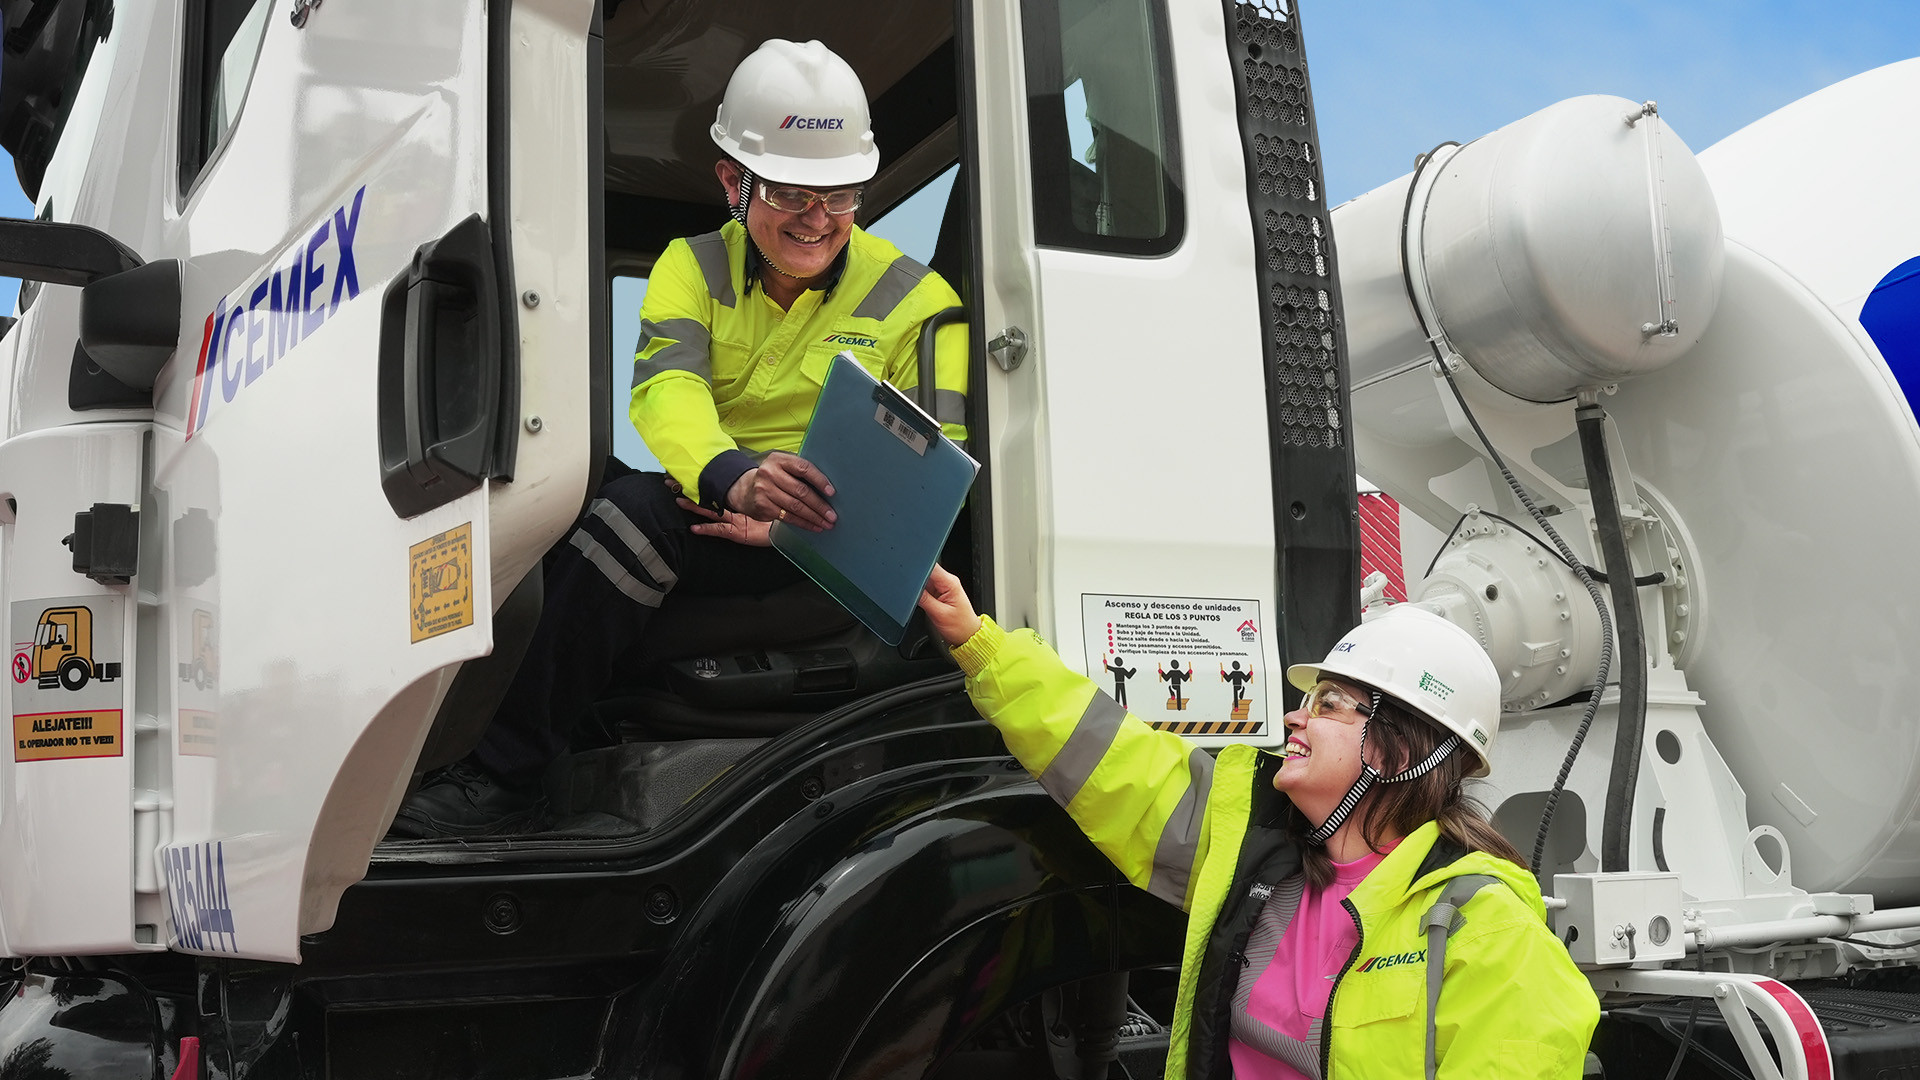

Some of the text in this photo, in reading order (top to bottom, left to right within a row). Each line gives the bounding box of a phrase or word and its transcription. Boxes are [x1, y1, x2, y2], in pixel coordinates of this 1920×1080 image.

[796, 118, 844, 130] CEMEX
[221, 184, 366, 404] CEMEX
[838, 336, 877, 348] CEMEX
[1105, 600, 1141, 608] Ascenso
[1143, 602, 1149, 610] y
[1150, 602, 1190, 610] descenso
[1205, 604, 1241, 612] unidades
[27, 738, 64, 748] OPERADOR
[65, 737, 78, 746] NO
[79, 736, 91, 745] TE
[1377, 949, 1427, 970] CEMEX
